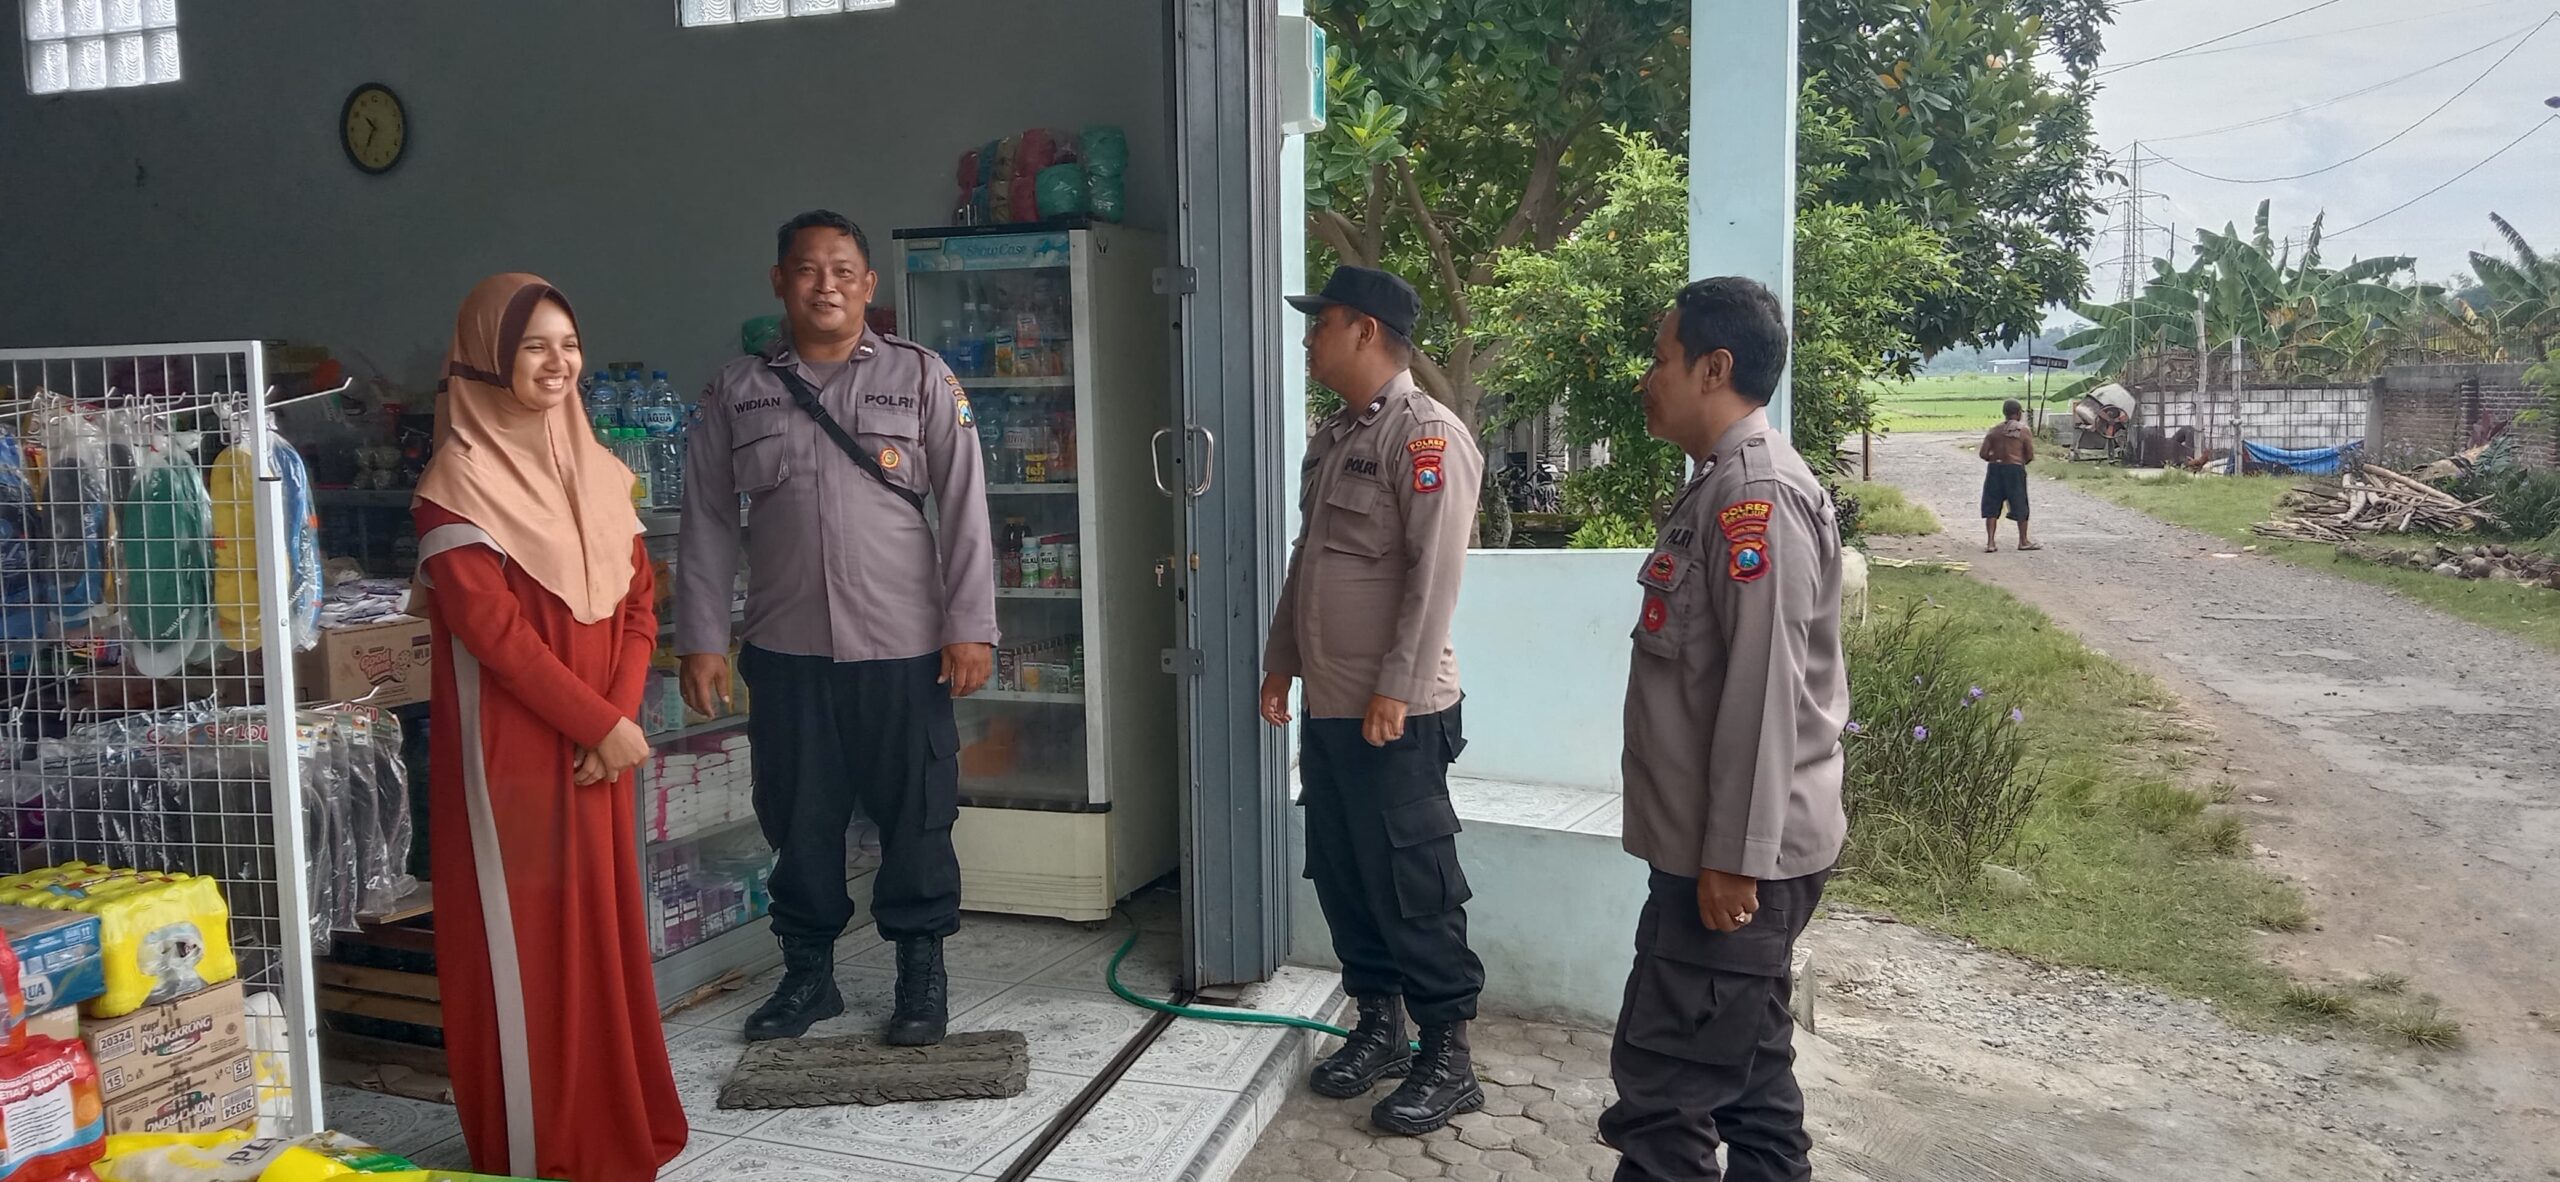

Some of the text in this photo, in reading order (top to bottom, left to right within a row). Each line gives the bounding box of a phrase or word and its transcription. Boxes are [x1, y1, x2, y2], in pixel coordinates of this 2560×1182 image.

[734, 397, 781, 414] WIDIAN
[864, 395, 914, 408] POLRI
[647, 413, 673, 424] AQUA
[1345, 458, 1378, 476] POLRI
[1722, 503, 1769, 522] POLRES
[361, 649, 391, 668] Good
[101, 1032, 132, 1050] 20324
[140, 1016, 212, 1056] NONGKRONG
[236, 1062, 248, 1075] 15
[107, 1075, 121, 1088] 15
[0, 1085, 30, 1100] ETIAP
[225, 1099, 253, 1118] 20324
